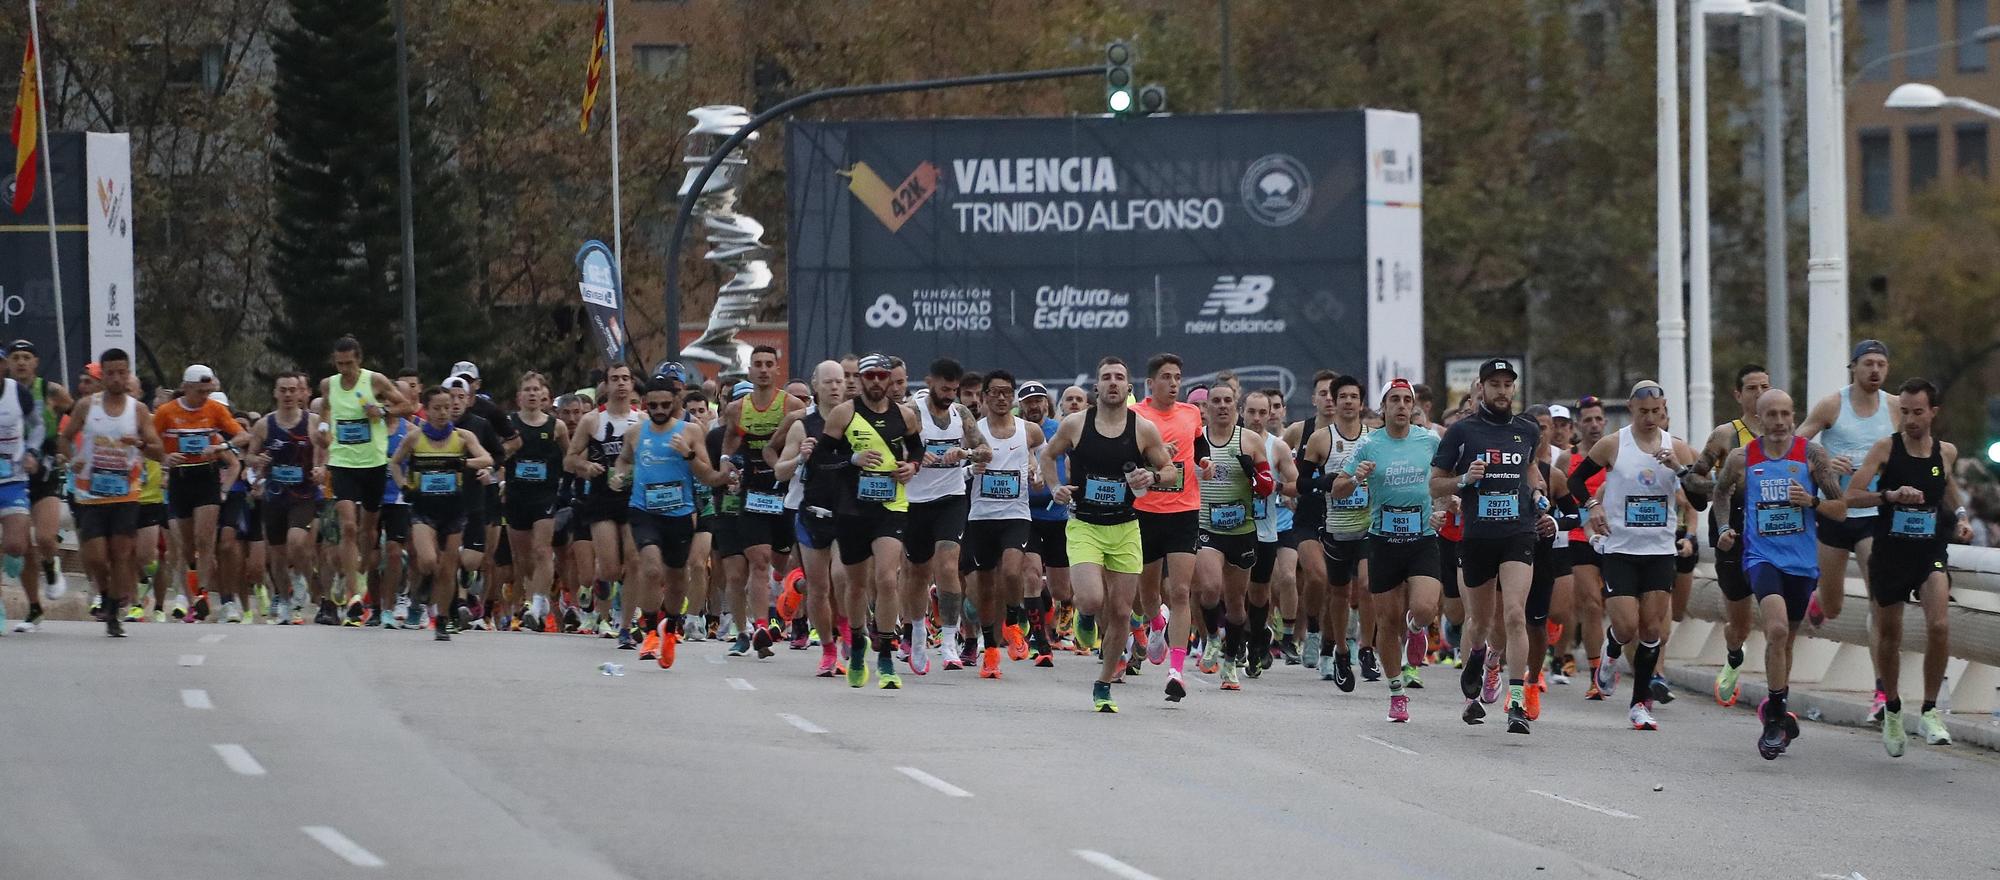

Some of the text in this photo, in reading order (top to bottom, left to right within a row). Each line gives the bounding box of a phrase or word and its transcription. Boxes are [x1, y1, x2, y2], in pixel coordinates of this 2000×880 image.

[953, 157, 1117, 194] VALENCIA
[891, 177, 926, 217] 42K
[952, 198, 1224, 233] TRINIDAD ALFONSO
[1036, 285, 1129, 307] Cultura del
[912, 301, 992, 316] TRINIDAD
[913, 316, 992, 331] ALFONSO
[1033, 306, 1130, 329] Esfuerzo
[1185, 318, 1286, 334] new balance
[1486, 449, 1522, 464] ISEO
[861, 488, 894, 497] ALBERTO
[990, 487, 1011, 495] YANIS
[1097, 485, 1115, 493] 4485
[1094, 492, 1116, 502] DUPS
[1354, 497, 1364, 505] GP
[1488, 500, 1511, 508] 29773
[1487, 508, 1512, 516] BEPPE
[1393, 524, 1409, 532] Toni
